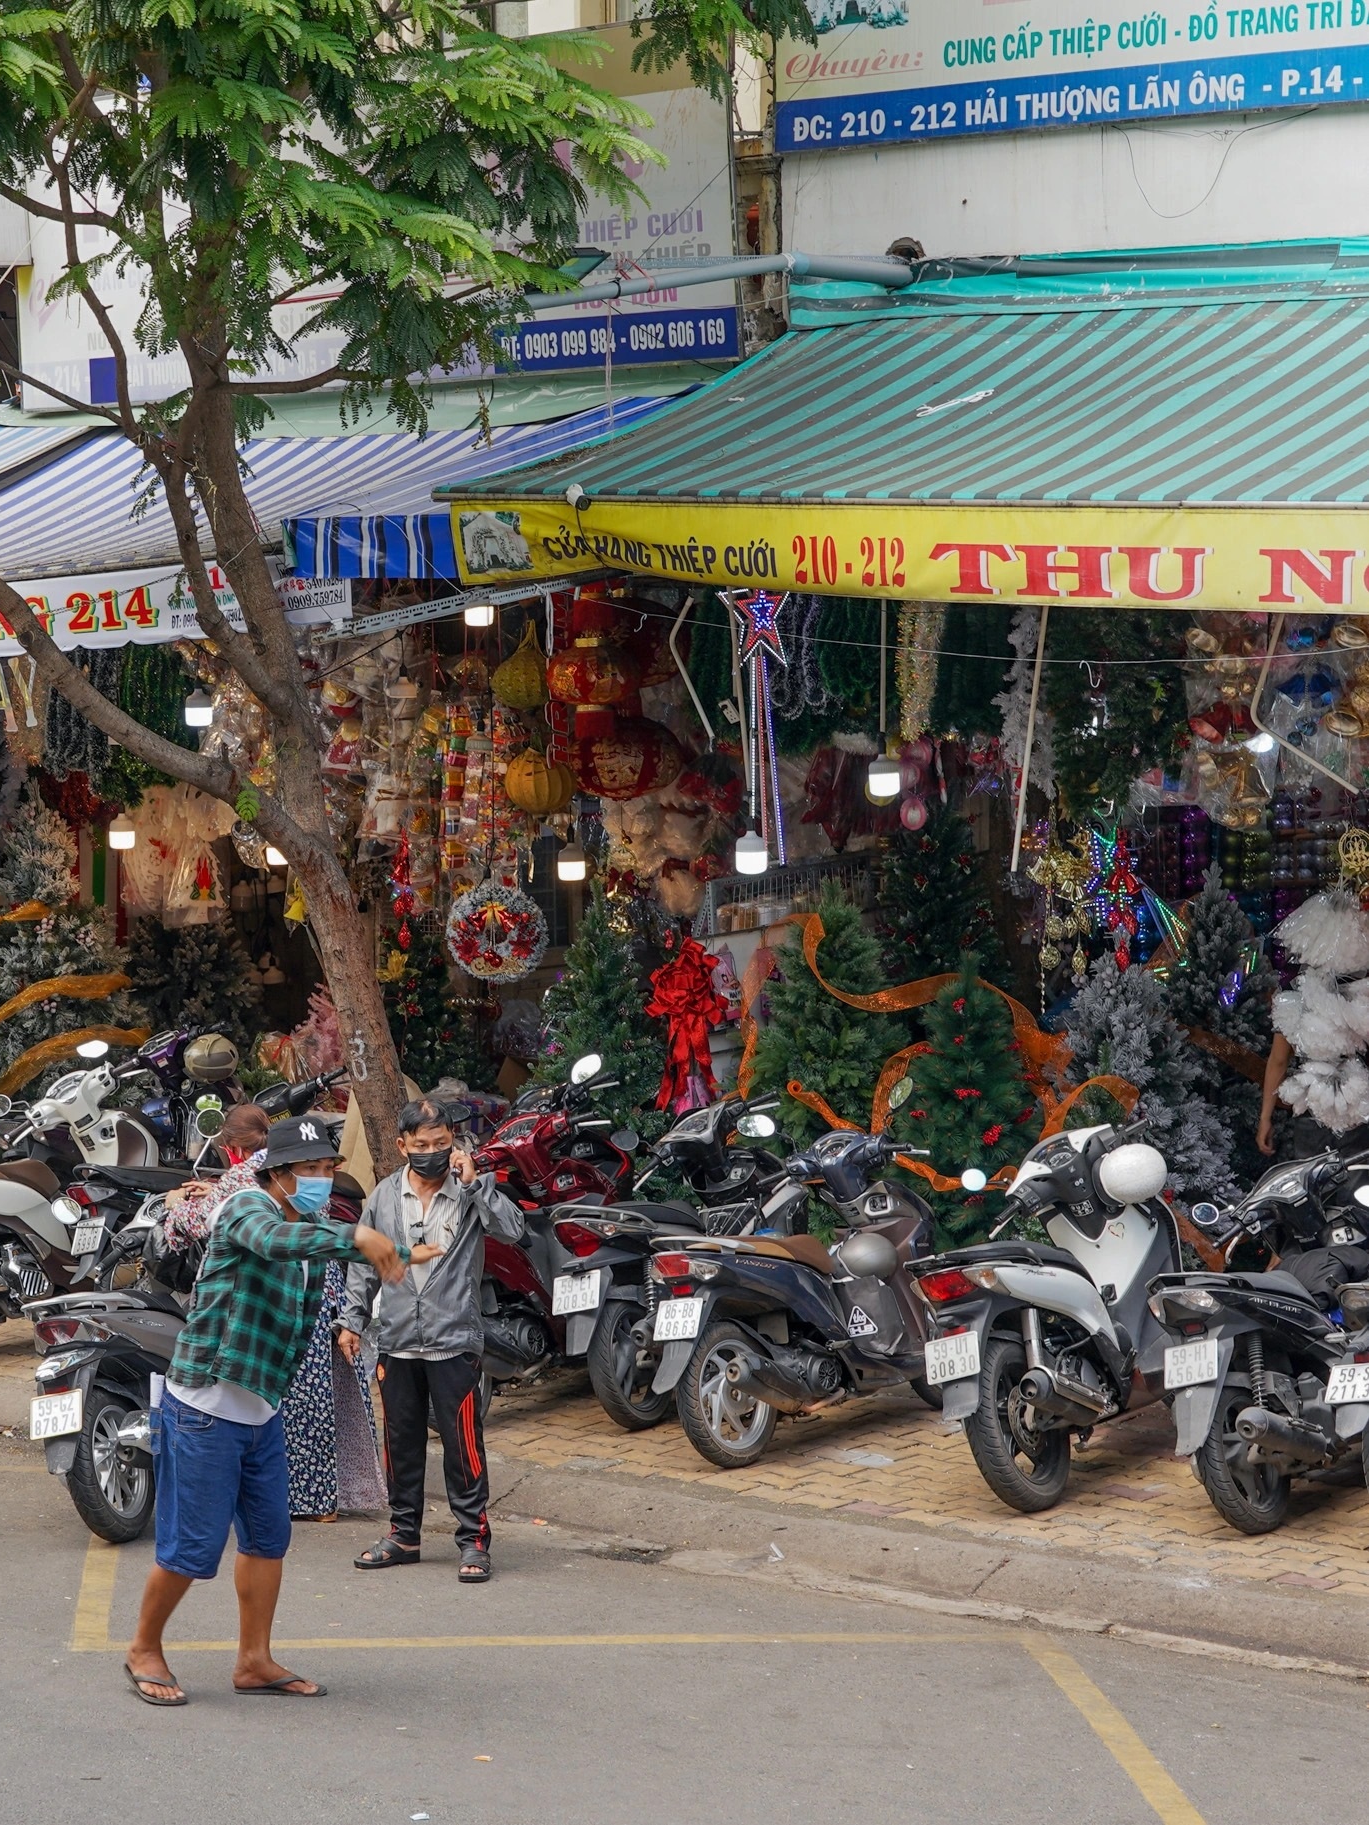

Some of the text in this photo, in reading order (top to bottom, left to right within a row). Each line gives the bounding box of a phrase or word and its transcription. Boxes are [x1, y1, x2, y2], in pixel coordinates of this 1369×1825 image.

[943, 0, 1298, 68] CUNG CẤP THIỆP CƯỚI ĐỒ TRANG
[785, 49, 923, 78] Chuyên:
[793, 65, 1343, 142] ĐC: 210 212 HẢI THƯỢNG LÃN ÔNG P.14
[524, 331, 559, 360] 0903
[562, 329, 587, 357] 099
[590, 327, 617, 354] 984
[629, 323, 665, 350] 0902
[668, 320, 695, 347] 606
[698, 318, 726, 345] 169
[652, 537, 716, 580] THIỆP
[724, 538, 778, 578] CƯỚI
[793, 535, 837, 586] 210
[860, 536, 905, 588] 212
[929, 543, 1214, 600] THU
[66, 586, 160, 634] 214
[561, 1276, 592, 1294] 59-E1
[556, 1290, 595, 1311] 208.94
[664, 1302, 695, 1320] 86-B8
[657, 1319, 696, 1337] 496.63
[933, 1337, 969, 1360] 59-U1
[1172, 1344, 1207, 1366] 59-H1
[930, 1355, 976, 1381] 308.30
[1167, 1361, 1214, 1385] 456.46
[38, 1395, 74, 1417] 59-G2
[35, 1413, 77, 1436] 878.74
